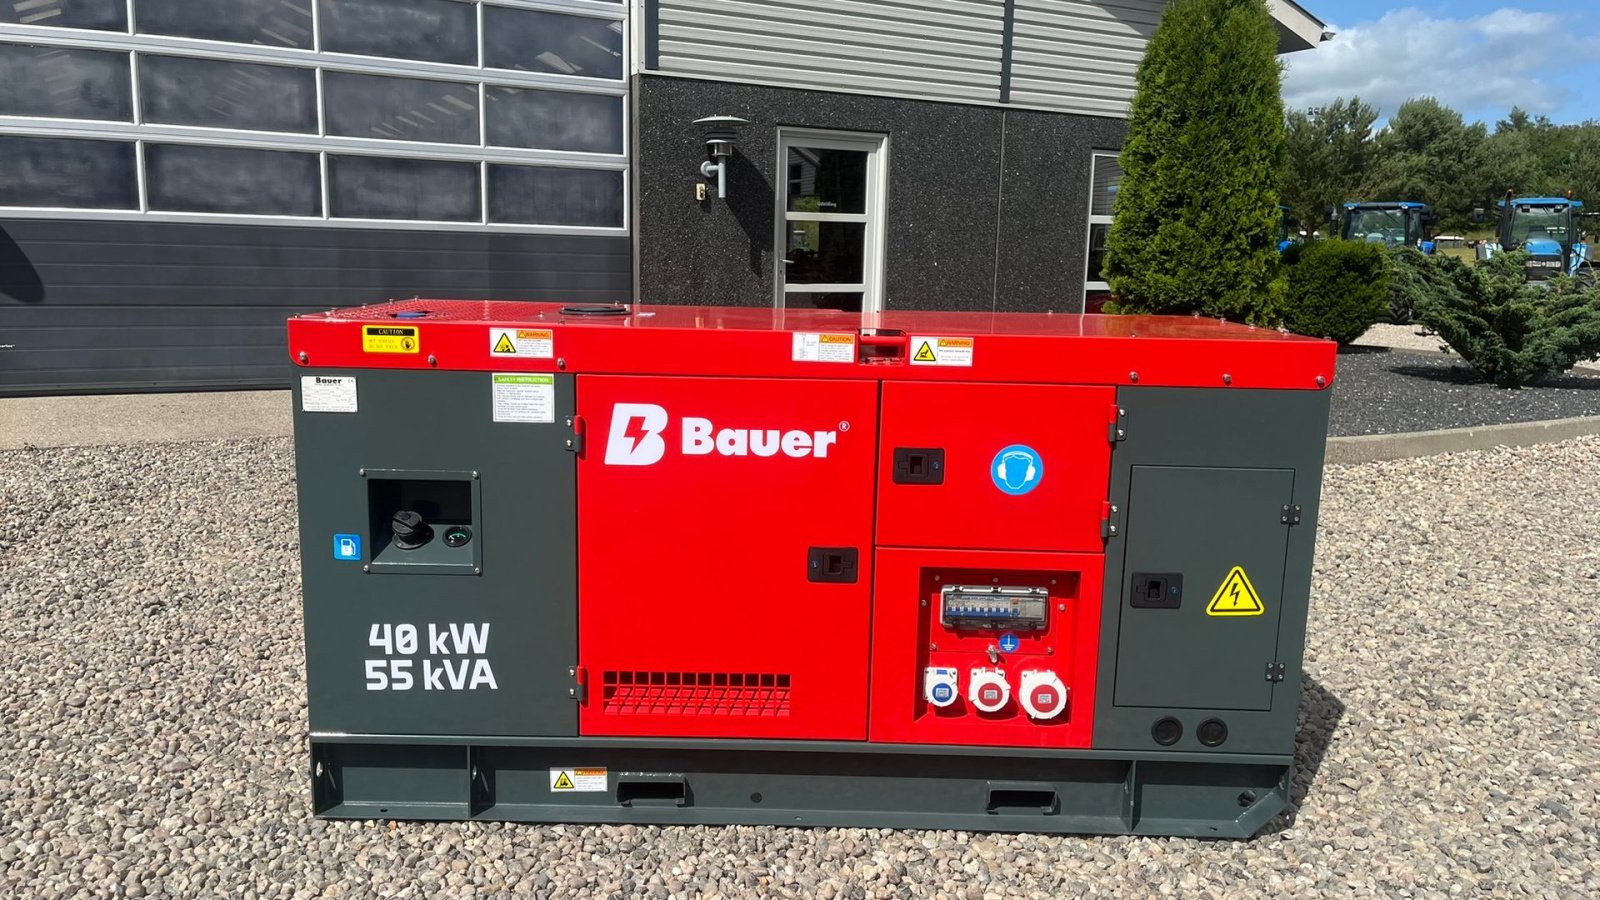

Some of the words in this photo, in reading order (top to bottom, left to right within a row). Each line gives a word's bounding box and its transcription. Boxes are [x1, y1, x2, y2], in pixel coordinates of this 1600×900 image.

[315, 376, 342, 384] Bauer
[368, 623, 418, 655] 40
[428, 622, 490, 655] kW
[365, 659, 414, 691] 55
[422, 658, 498, 690] kVA
